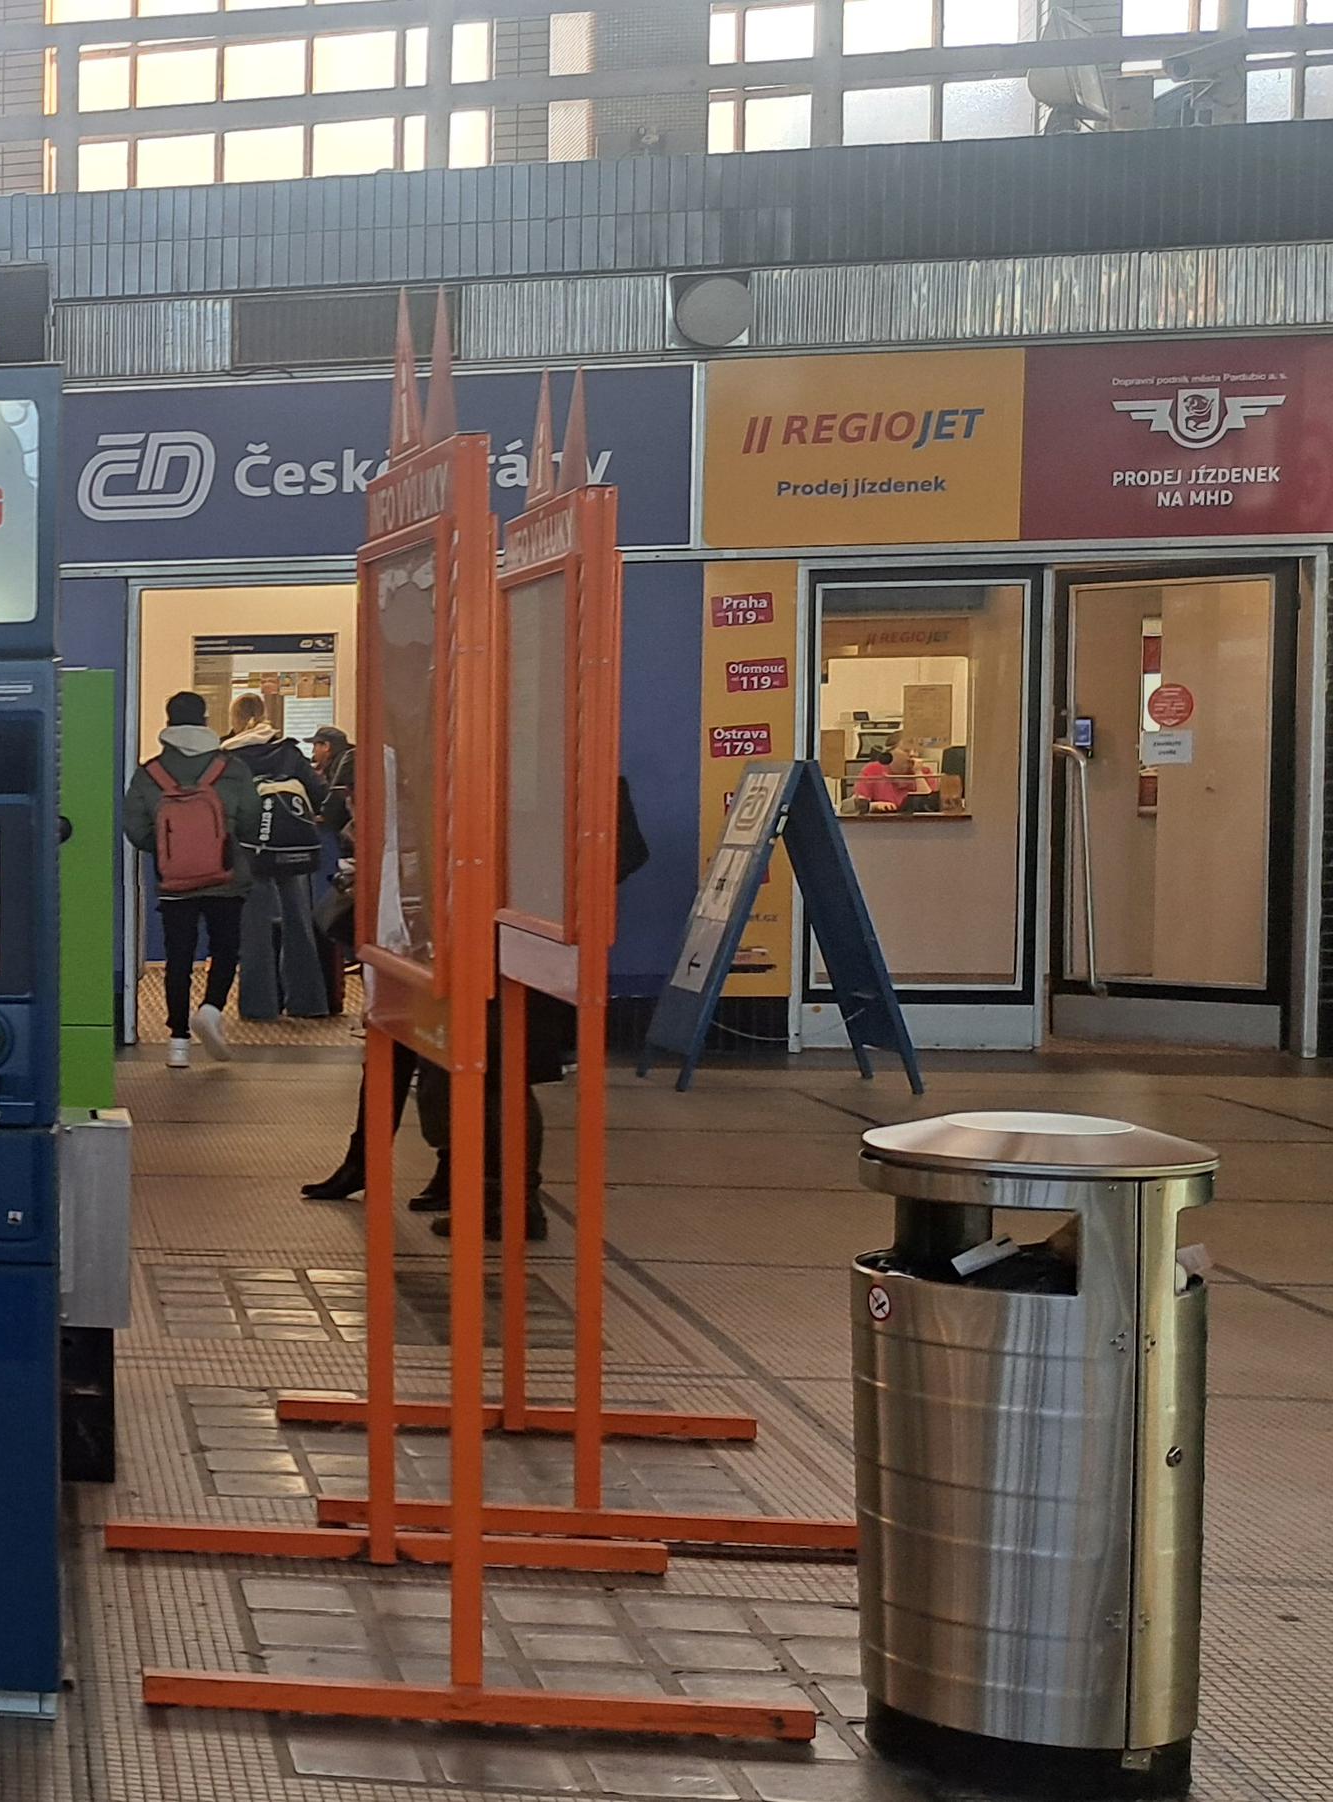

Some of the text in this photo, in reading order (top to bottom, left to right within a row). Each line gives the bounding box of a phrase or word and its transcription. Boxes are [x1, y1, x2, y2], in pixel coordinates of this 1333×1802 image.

[1112, 376, 1155, 387] Dopravní
[1156, 375, 1189, 387] podnik
[781, 408, 985, 450] REGIOJET
[1112, 464, 1282, 487] PRODEJ JÍZDENEK
[777, 475, 947, 499] Prodej jízdenek
[1157, 489, 1234, 507] NA MHD
[722, 596, 768, 610] Praha
[724, 611, 757, 625] 119
[728, 664, 785, 674] Olomouc
[740, 676, 772, 690] 119
[713, 728, 768, 740] Ostrava
[722, 741, 755, 755] 179
